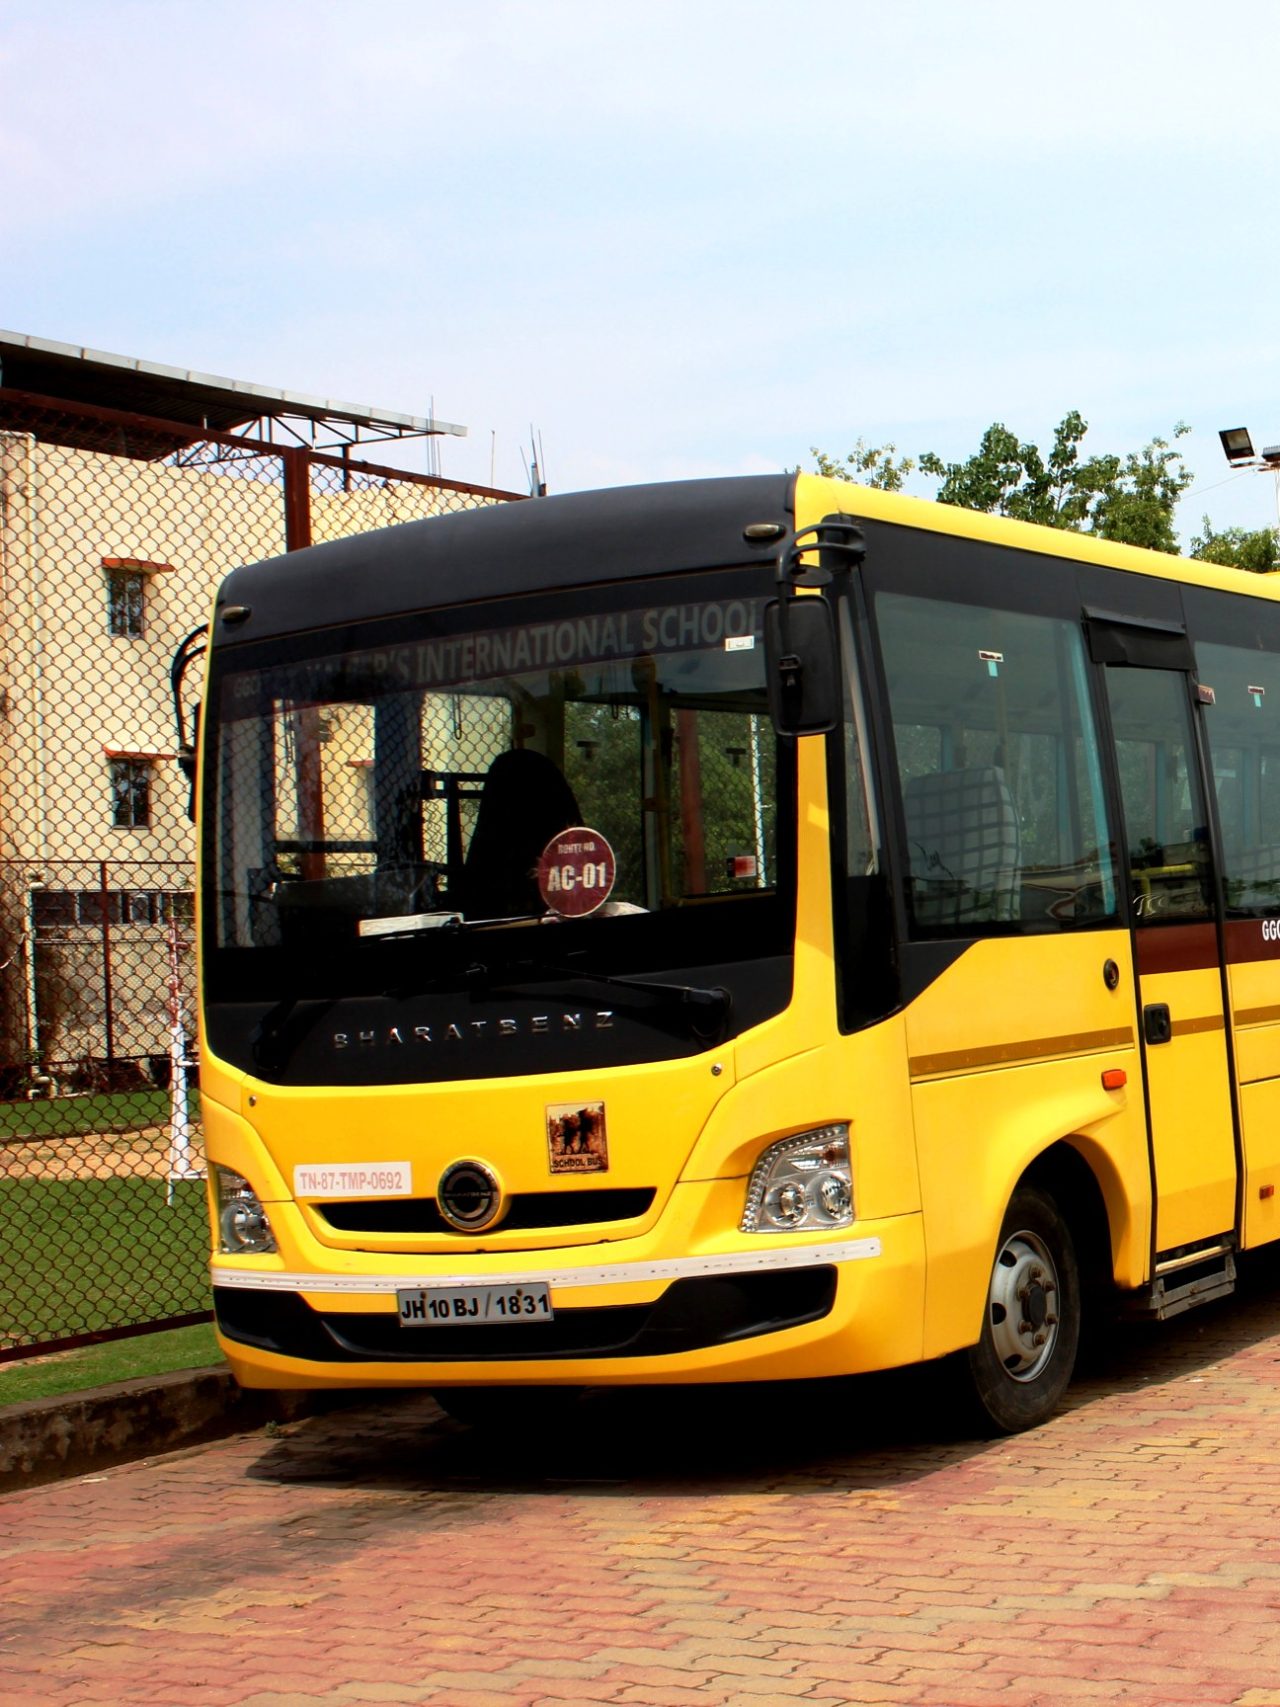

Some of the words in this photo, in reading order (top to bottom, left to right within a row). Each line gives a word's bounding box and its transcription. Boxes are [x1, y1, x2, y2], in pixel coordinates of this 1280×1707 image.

[417, 613, 635, 684] INTERNATIONAL
[643, 601, 763, 649] SCHOOL
[547, 862, 606, 891] AC-01
[334, 1010, 613, 1048] BHARATBENZ
[553, 1157, 586, 1169] SCHOOL
[587, 1156, 604, 1167] BUS
[300, 1171, 402, 1190] TN-87-TMP-0692
[402, 1299, 426, 1319] JH
[429, 1298, 450, 1318] 10
[453, 1297, 478, 1317] BJ
[496, 1294, 549, 1316] 1831
